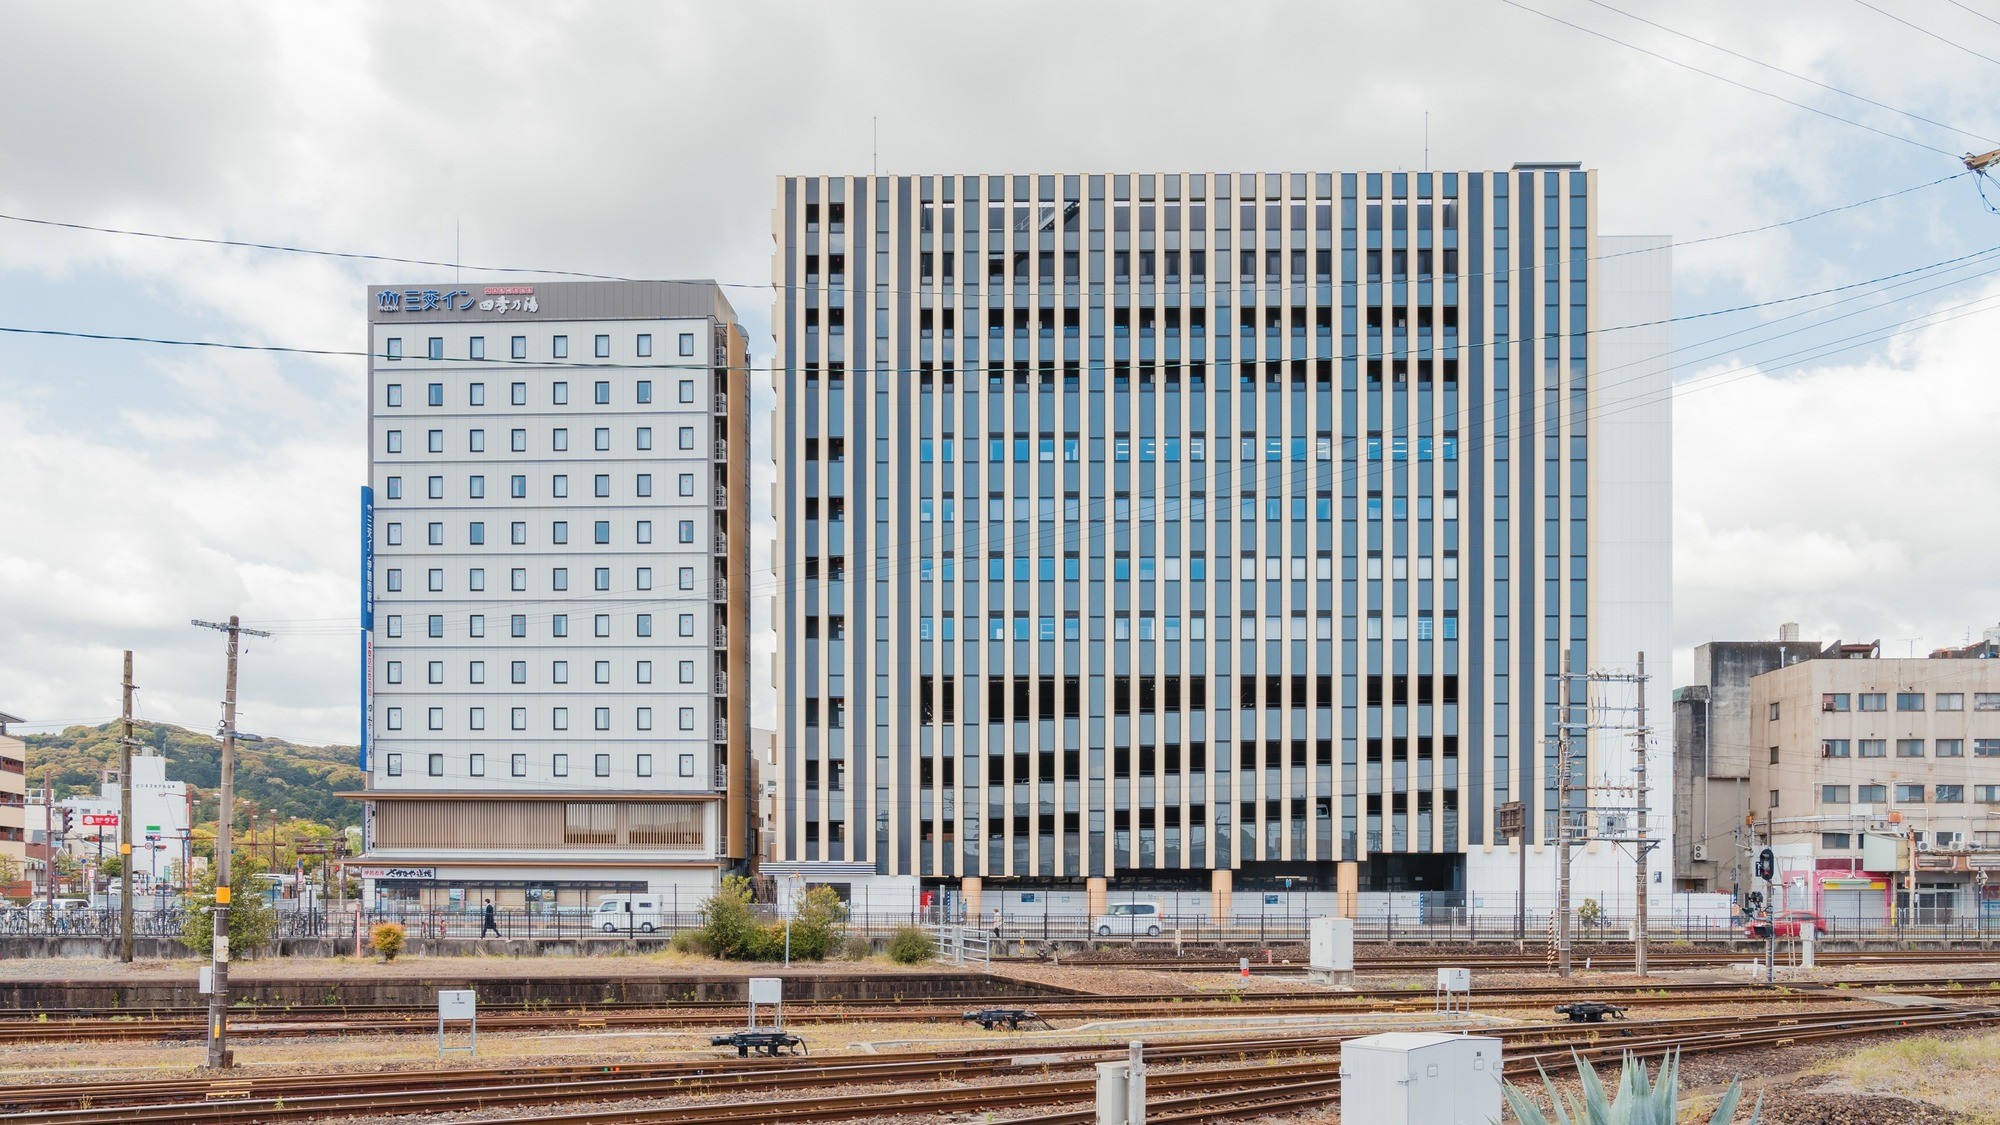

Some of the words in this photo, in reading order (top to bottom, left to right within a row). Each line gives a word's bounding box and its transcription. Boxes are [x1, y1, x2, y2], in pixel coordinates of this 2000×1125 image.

[404, 290, 476, 312] 三交イン
[479, 295, 540, 314] 四季乃湯
